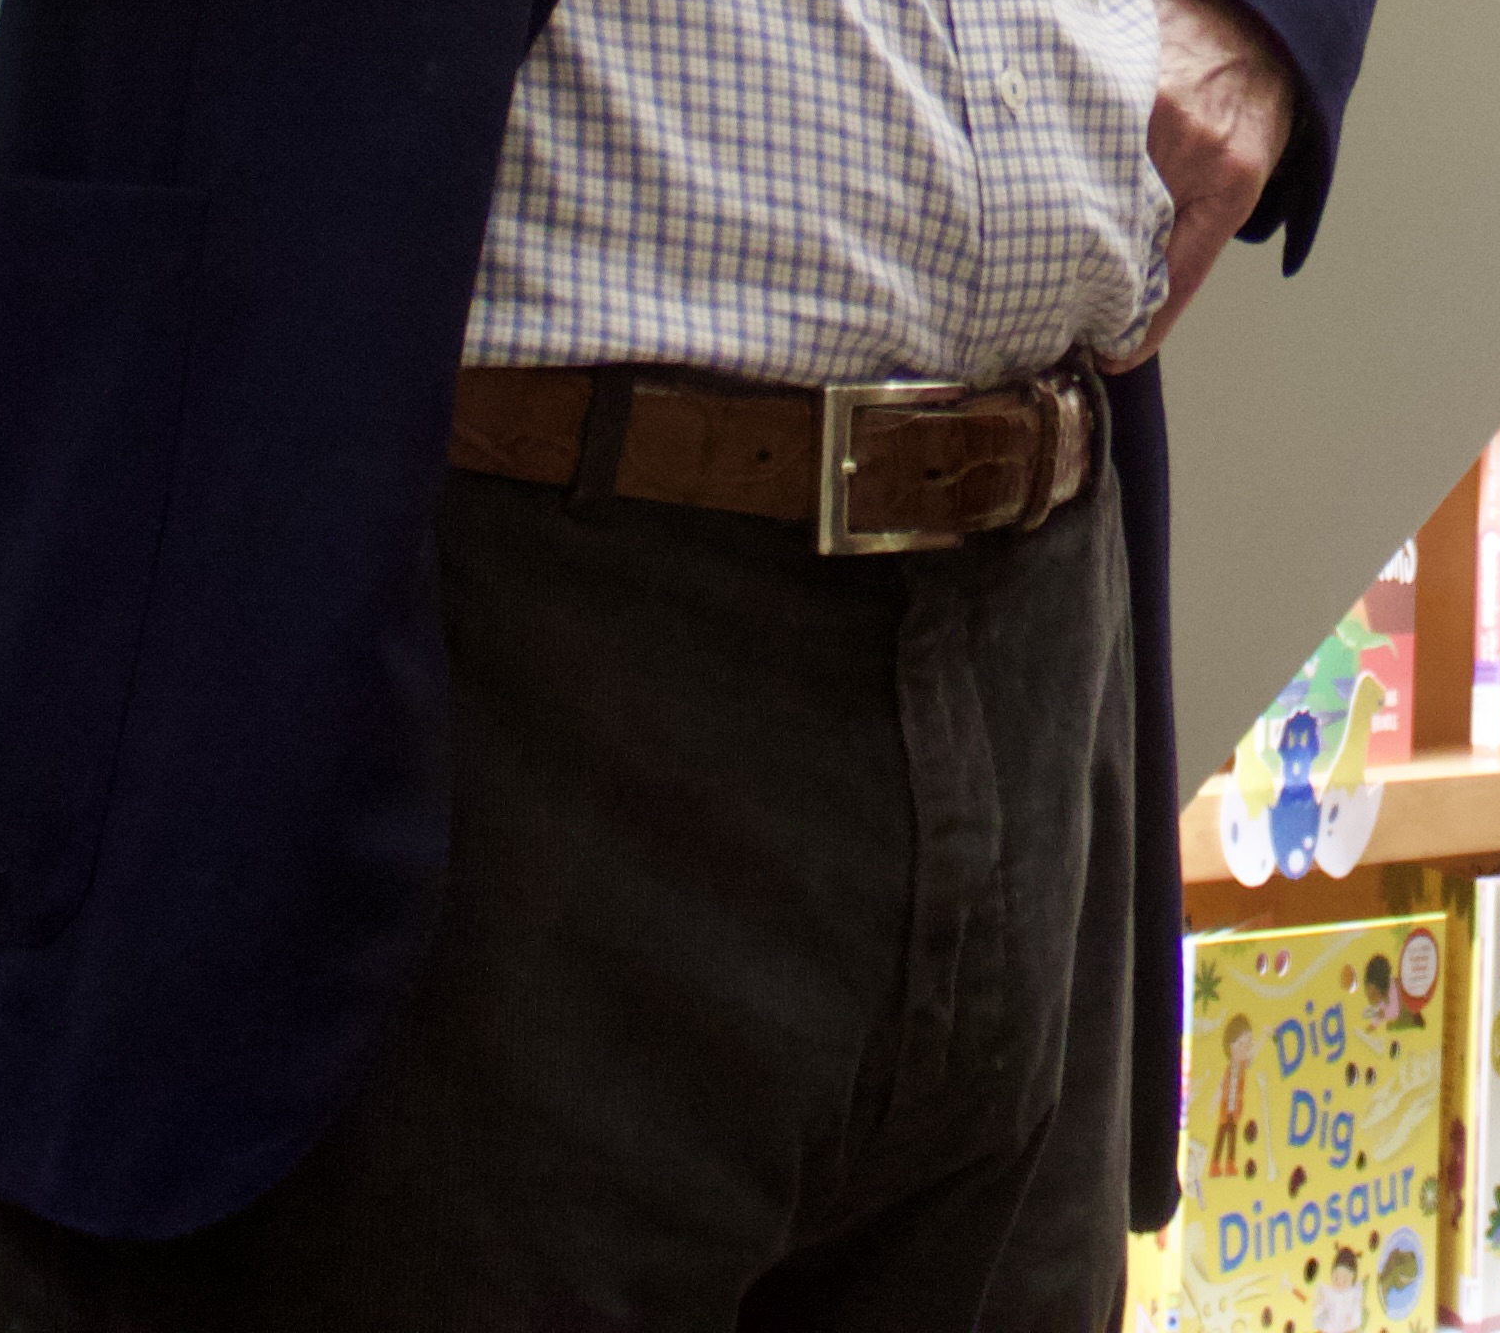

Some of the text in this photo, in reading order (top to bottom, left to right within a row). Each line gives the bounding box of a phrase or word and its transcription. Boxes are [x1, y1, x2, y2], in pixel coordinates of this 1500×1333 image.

[1274, 1000, 1347, 1080] Dig
[1286, 1089, 1354, 1169] Dig
[1218, 1165, 1416, 1275] Dinosaur
